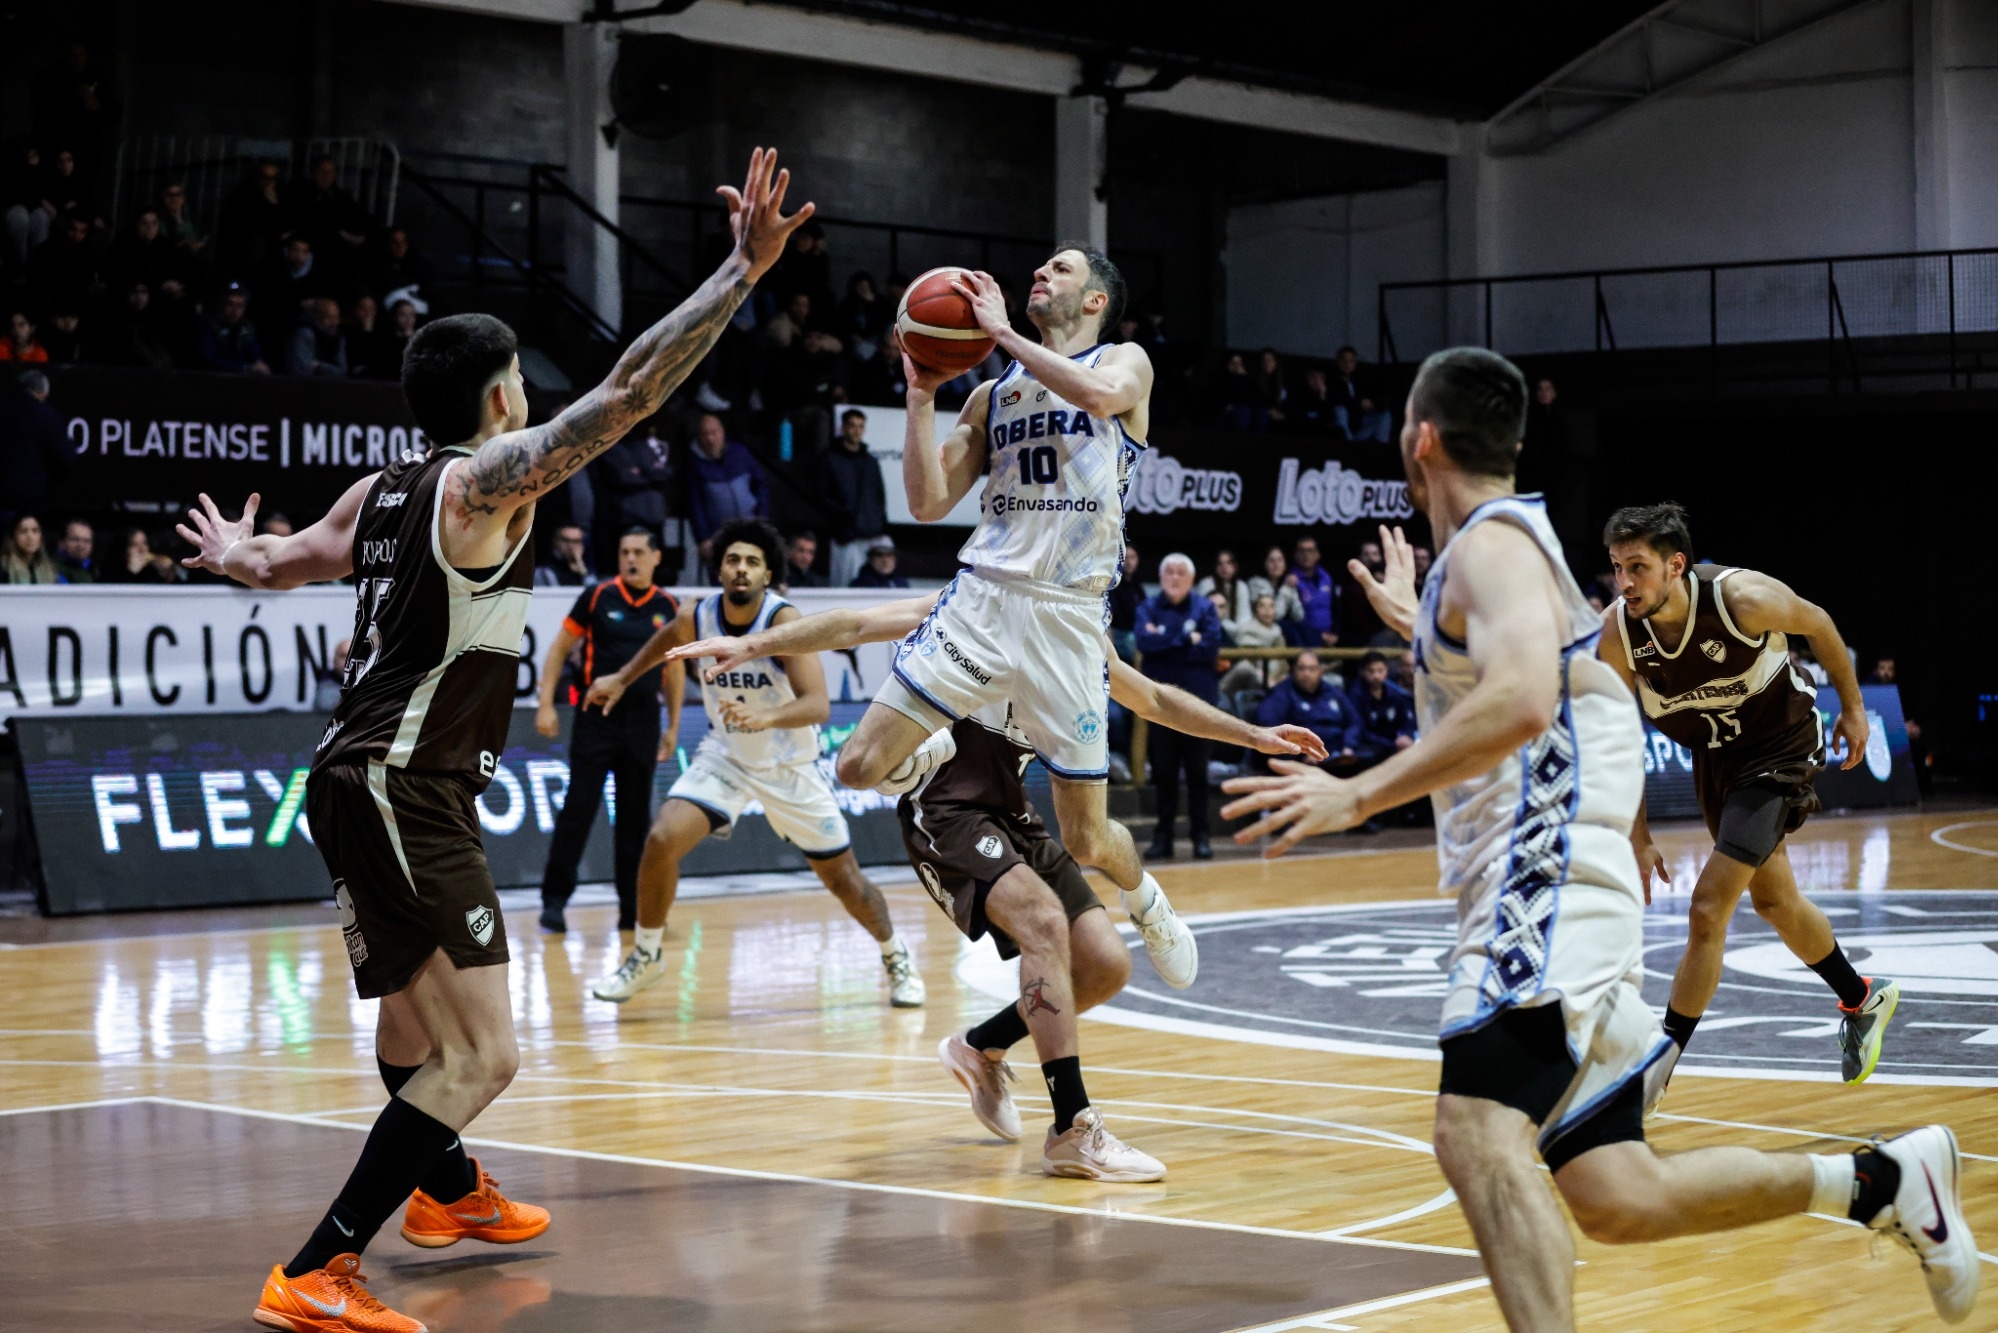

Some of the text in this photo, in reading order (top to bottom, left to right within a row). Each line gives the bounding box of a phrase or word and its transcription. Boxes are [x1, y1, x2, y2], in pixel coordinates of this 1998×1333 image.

[1001, 396, 1019, 406] LNB
[101, 419, 270, 462] PLATENSE
[993, 410, 1095, 451] OBERA
[1017, 446, 1059, 486] 10
[1007, 497, 1098, 513] Envasando
[943, 641, 992, 686] CitySalud
[1634, 646, 1655, 658] LNB
[1700, 709, 1742, 749] 15
[91, 768, 317, 854] FLEX
[472, 912, 490, 933] CAP
